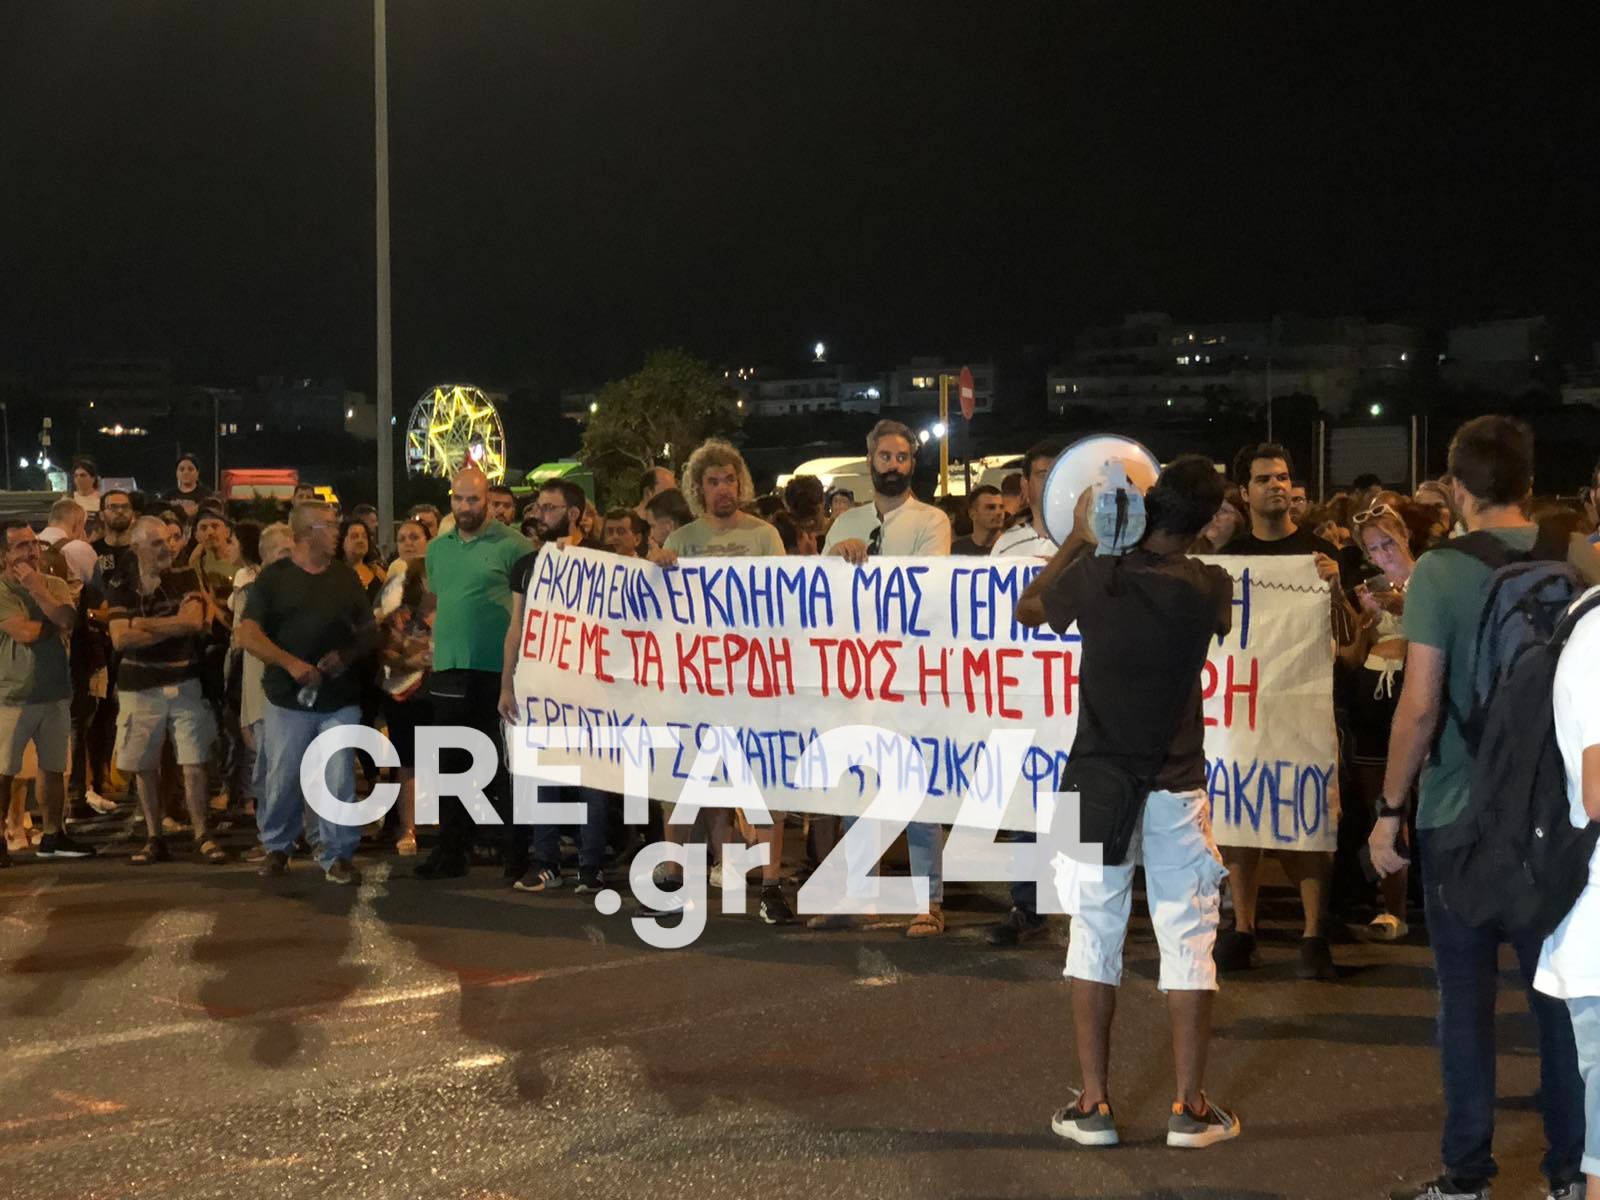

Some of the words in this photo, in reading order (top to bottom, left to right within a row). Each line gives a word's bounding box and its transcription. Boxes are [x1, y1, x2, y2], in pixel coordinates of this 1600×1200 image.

[534, 552, 605, 619] ΑΚΟΜΑ
[608, 565, 663, 622] ΕΝΑ
[662, 566, 833, 628] ΕΓΚΛΗΜΑ
[852, 565, 931, 637] ΜΑΣ
[523, 608, 576, 671] ΕΙΤΕ
[579, 621, 615, 684] ΜΕ
[621, 629, 665, 692] ΤΑ
[675, 632, 795, 698] ΚΕΡΔΗ
[809, 637, 905, 702] ΤΟΥΣ
[962, 647, 1024, 720] ΜΕ
[525, 697, 656, 773] ΕΡΓΑΤΙΚΑ
[667, 721, 829, 792] ΣΩΜΑΤΕΙΑ
